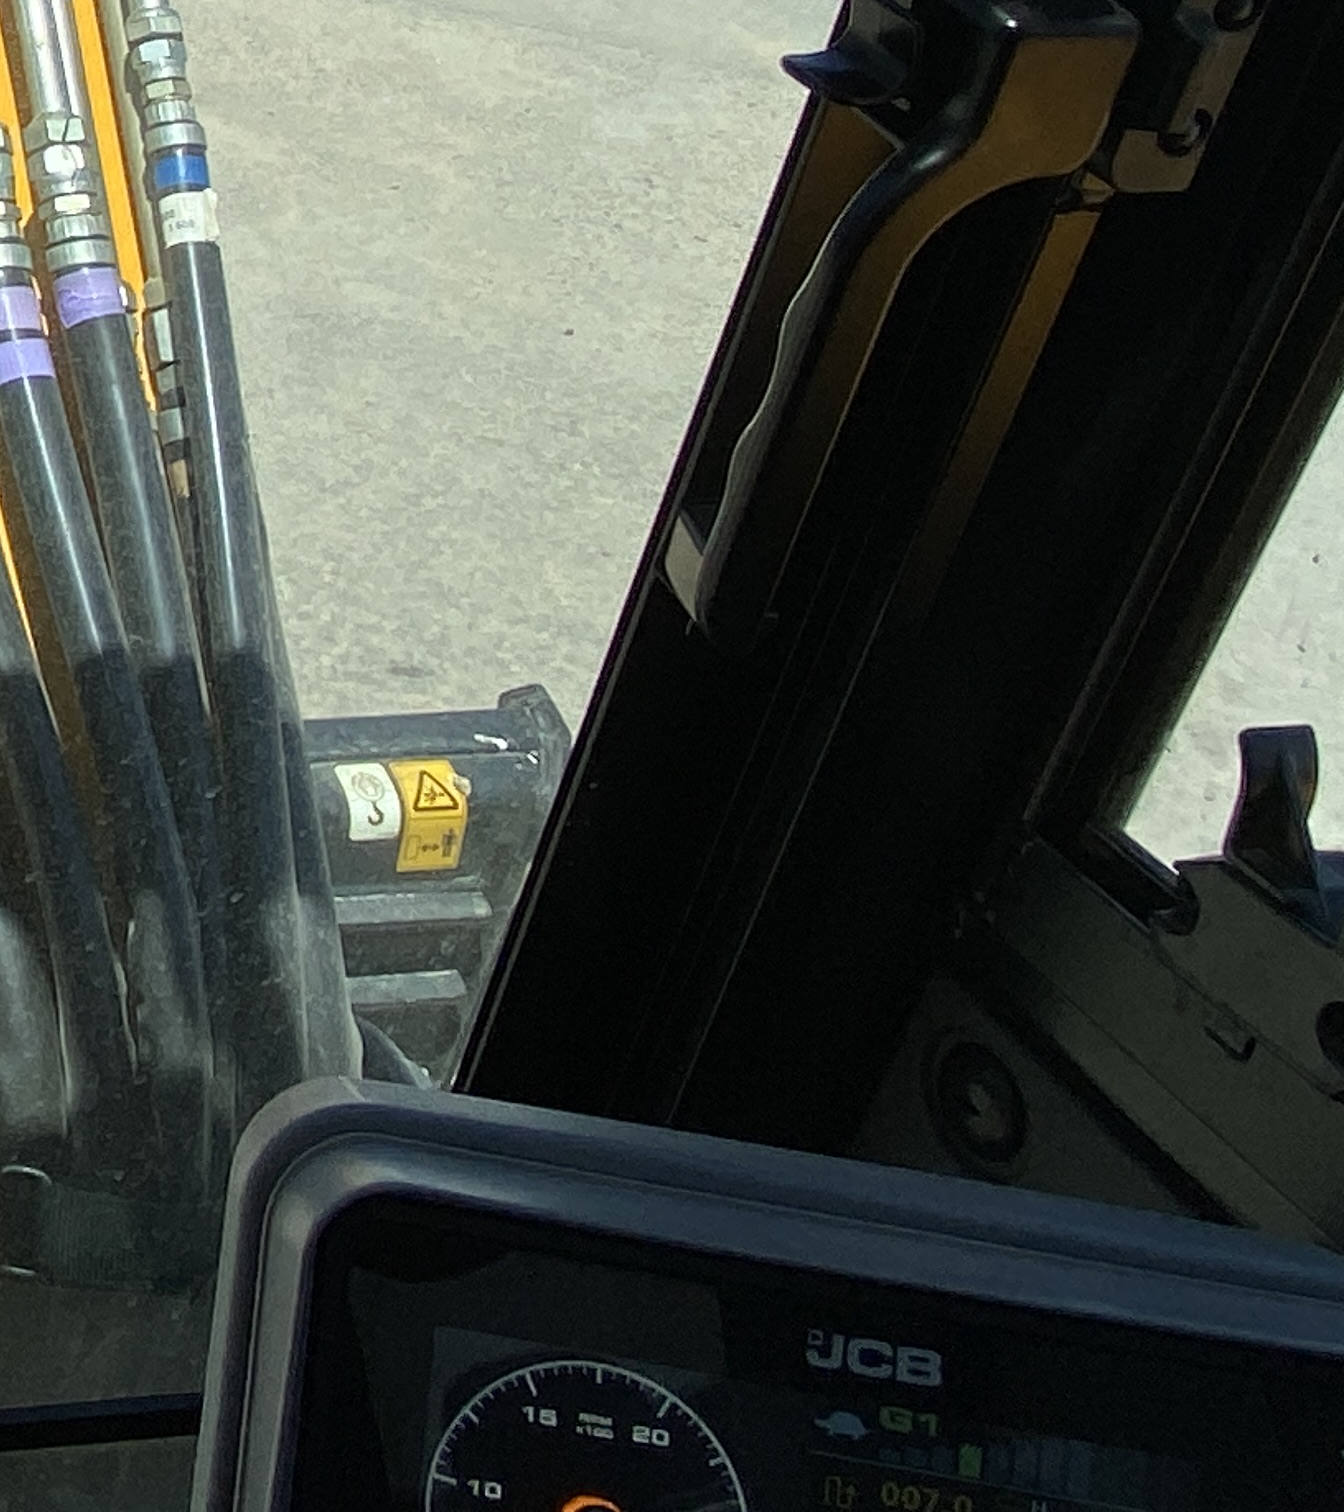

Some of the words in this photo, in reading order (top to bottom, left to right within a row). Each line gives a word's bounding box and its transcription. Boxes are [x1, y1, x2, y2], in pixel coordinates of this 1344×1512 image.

[805, 1329, 943, 1387] JCB
[521, 1405, 558, 1428] 15
[877, 1405, 939, 1439] G1
[631, 1424, 671, 1447] 20
[466, 1479, 503, 1499] 10
